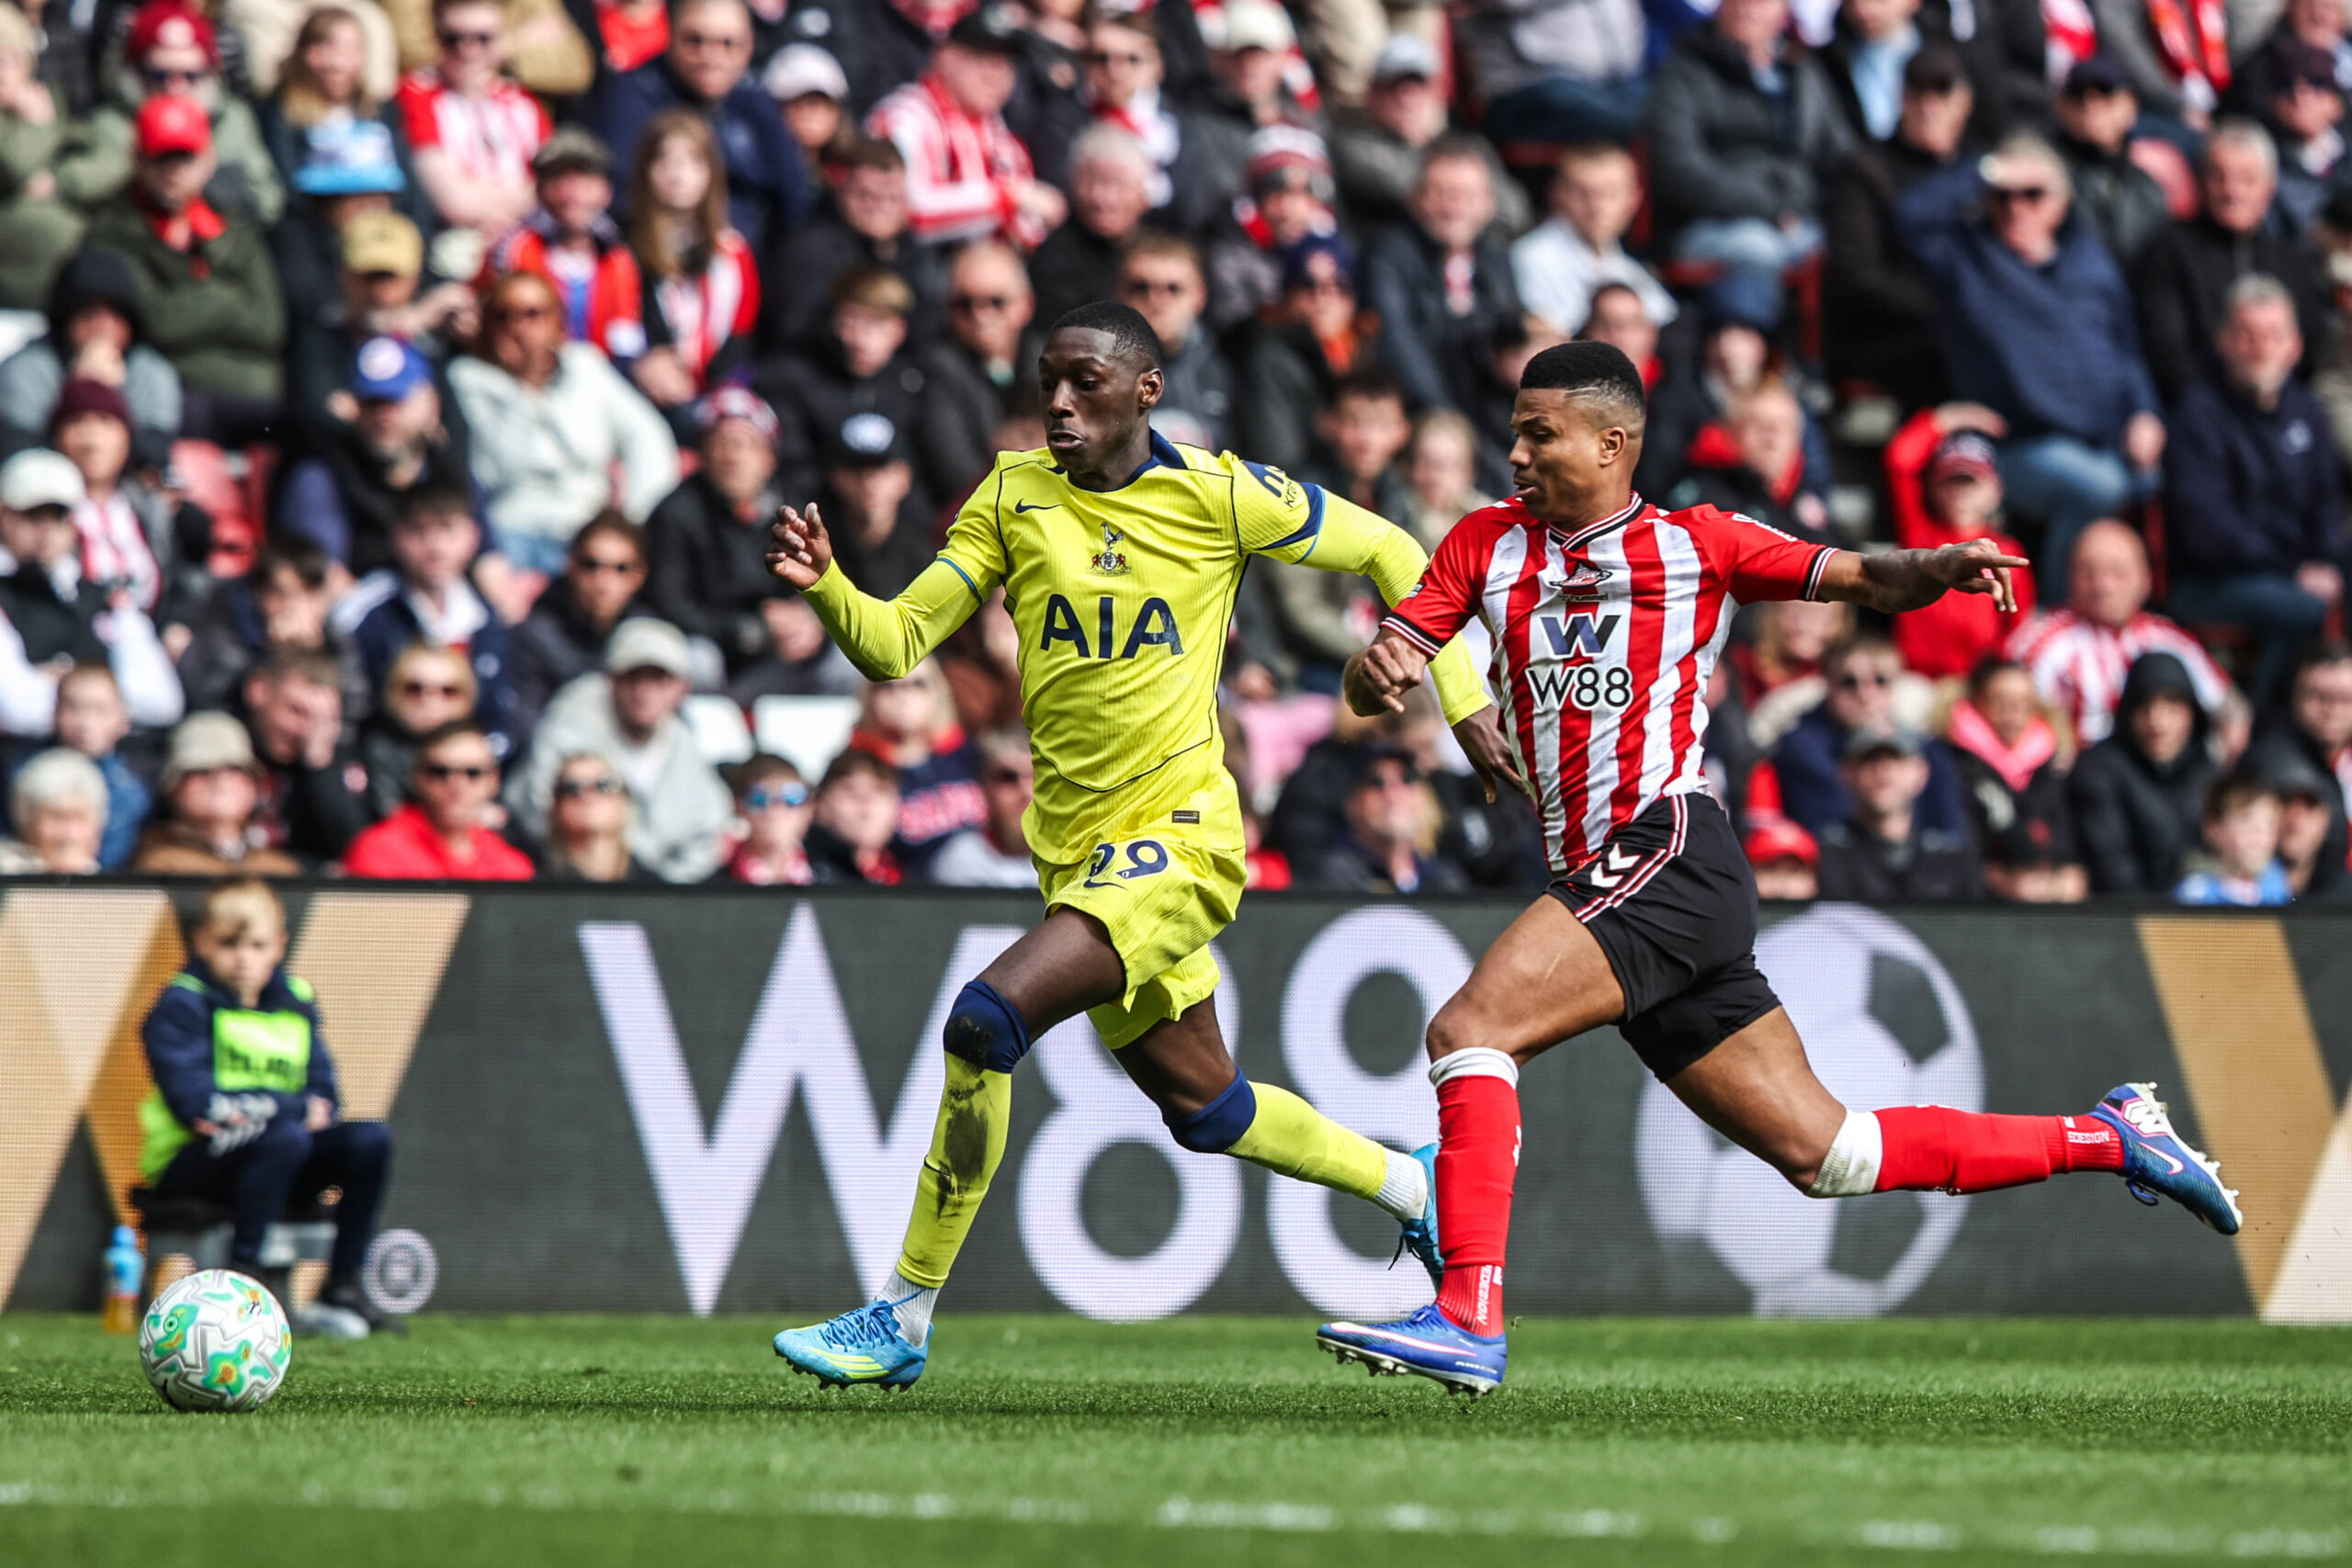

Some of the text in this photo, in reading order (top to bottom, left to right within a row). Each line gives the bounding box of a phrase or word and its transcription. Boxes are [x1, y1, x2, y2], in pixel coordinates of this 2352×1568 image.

[1040, 593, 1184, 660] AIA
[1527, 666, 1631, 707] W88
[1088, 840, 1169, 879] 29
[577, 901, 1476, 1323] W88
